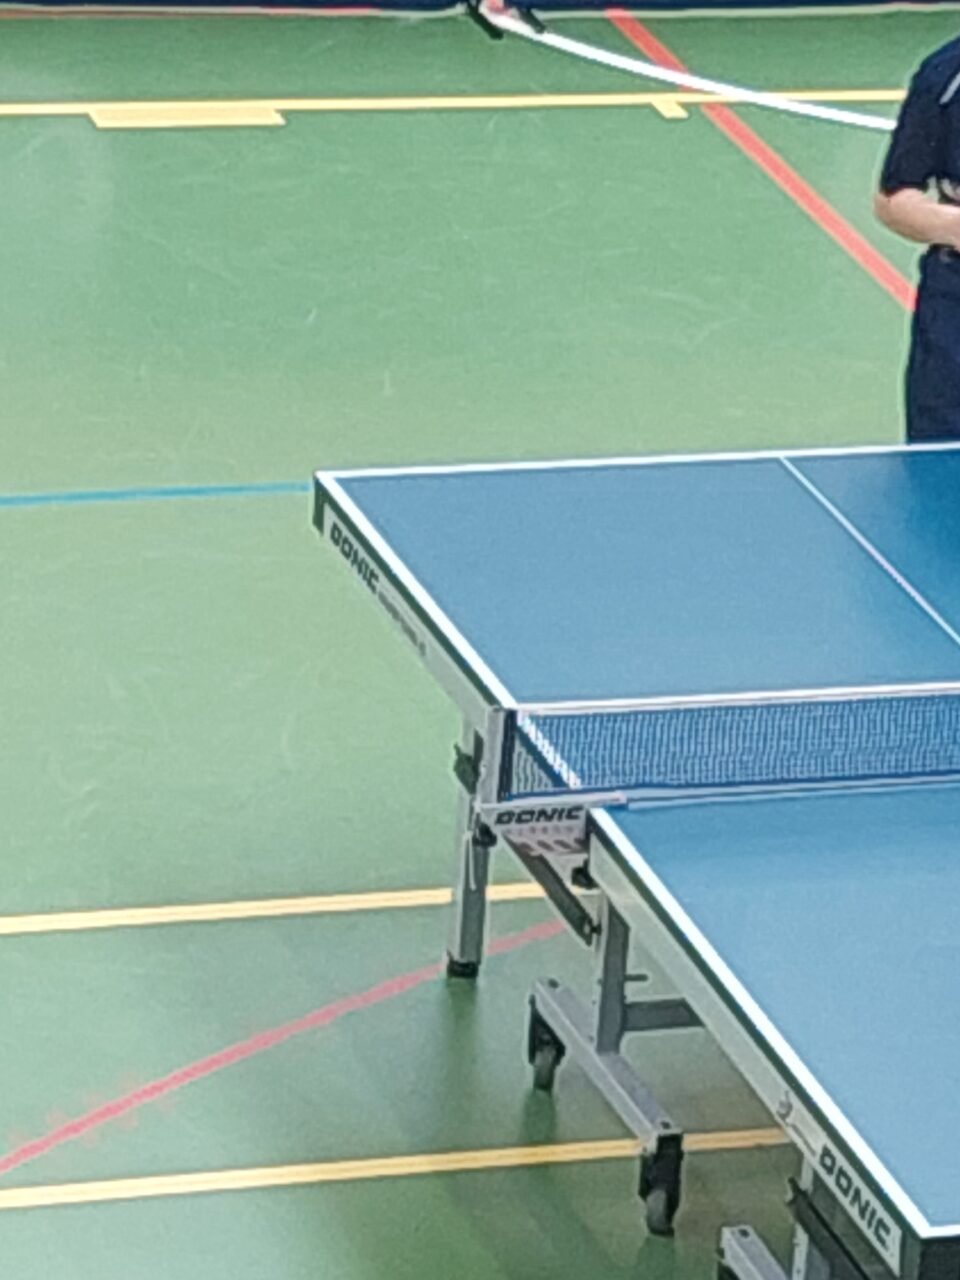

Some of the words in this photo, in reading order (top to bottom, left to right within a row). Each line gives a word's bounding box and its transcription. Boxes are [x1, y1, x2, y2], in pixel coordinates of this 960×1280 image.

[330, 521, 380, 595] DONIC
[494, 805, 584, 826] DONIC
[819, 1144, 892, 1252] DONIC
